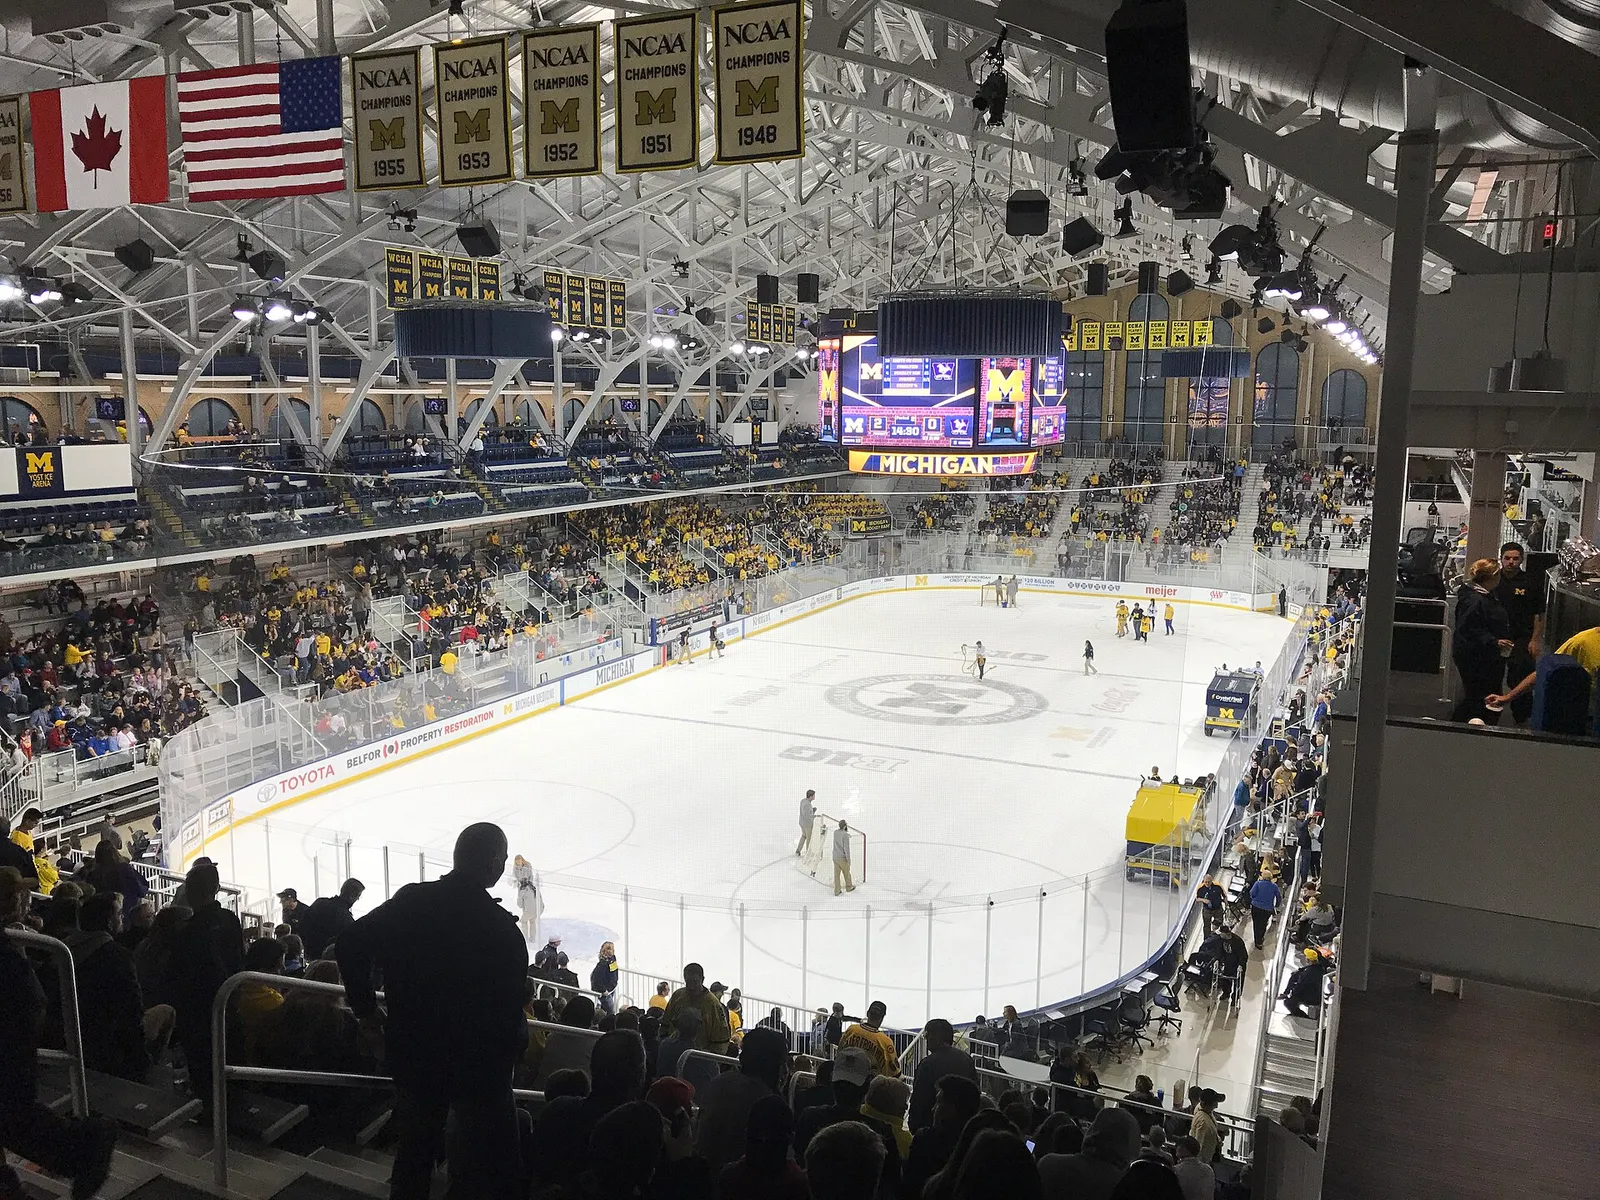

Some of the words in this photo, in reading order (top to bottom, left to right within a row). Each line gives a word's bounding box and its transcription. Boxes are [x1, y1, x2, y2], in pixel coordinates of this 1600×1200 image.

[724, 20, 791, 47] NCAA
[624, 34, 686, 58] NCAA
[532, 45, 589, 69] NCAA
[726, 50, 790, 70] CHAMPIONS
[443, 57, 498, 81] NCAA
[625, 63, 686, 81] CHAMPIONS
[359, 68, 412, 90] NCAA
[533, 74, 589, 91] CHAMPIONS
[360, 94, 411, 110] CHAMPIONS
[445, 85, 498, 102] CHAMPIONS
[735, 76, 780, 116] M
[635, 88, 676, 125] M
[540, 97, 580, 134] M
[369, 118, 406, 150] M
[454, 108, 491, 144] M
[737, 125, 777, 146] 1948
[543, 144, 578, 162] 1952
[641, 135, 673, 154] 1951
[373, 160, 405, 177] 1955
[457, 152, 490, 170] 1953
[388, 253, 411, 265] WCHA
[420, 258, 442, 269] WCHA
[450, 262, 471, 273] WCHA
[479, 265, 497, 276] CCHA
[393, 280, 408, 293] M
[546, 275, 561, 284] CCHA
[568, 279, 583, 287] CCHA
[591, 282, 604, 290] CCHA
[611, 284, 624, 292] CCHA
[426, 283, 439, 296] M
[455, 286, 467, 298] M
[483, 289, 495, 300] M
[548, 297, 559, 309] M
[571, 300, 581, 312] M
[593, 303, 603, 314] M
[614, 304, 623, 315] M
[861, 363, 882, 380] M
[988, 370, 1025, 402] M
[844, 418, 863, 433] M
[874, 418, 882, 429] 2
[927, 418, 935, 429] 0
[25, 452, 54, 473] M
[879, 455, 993, 474] MICHIGAN
[29, 474, 44, 482] YOST
[45, 473, 53, 481] ICE
[32, 480, 52, 488] ARENA
[852, 520, 866, 532] M
[915, 575, 928, 586] M
[1145, 586, 1177, 597] meijer
[596, 658, 635, 686] MICHIGAN
[503, 702, 513, 715] M
[515, 695, 536, 711] MICHIGAN
[1219, 708, 1234, 719] M
[444, 709, 495, 735] RESTORATION
[346, 748, 382, 770] BELFOR
[400, 727, 443, 751] PROPERTY
[278, 763, 336, 794] TOYOTA
